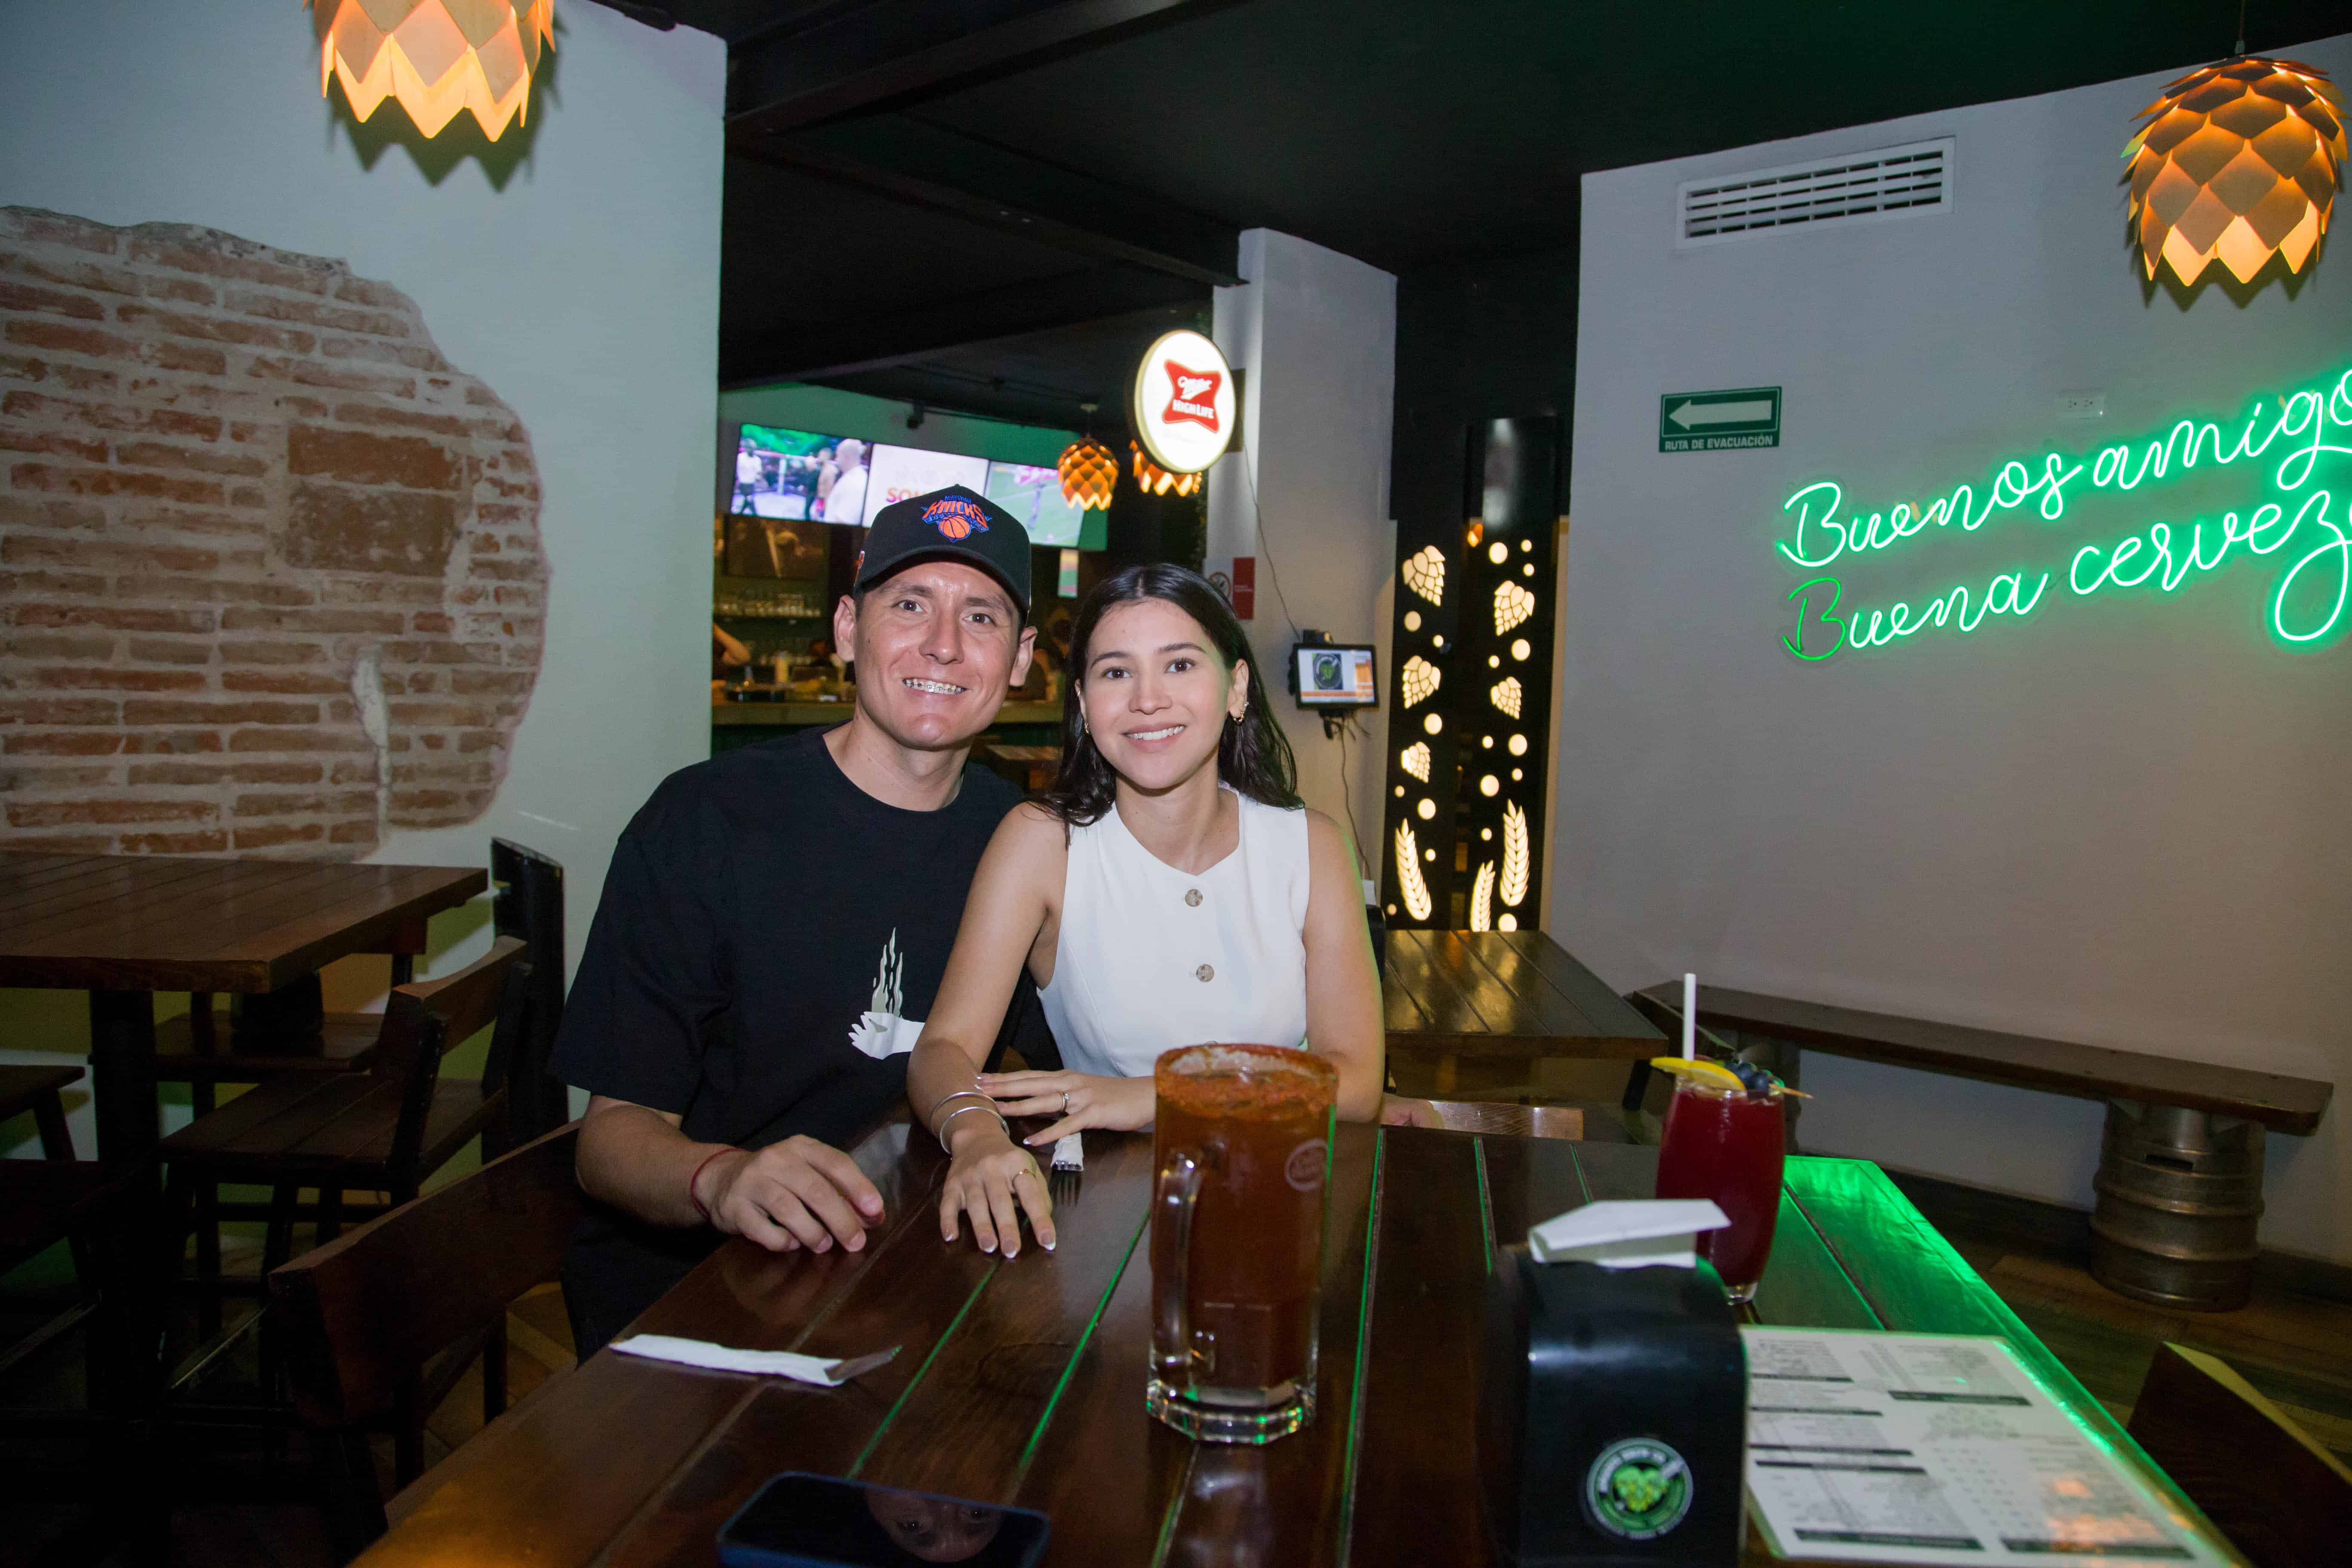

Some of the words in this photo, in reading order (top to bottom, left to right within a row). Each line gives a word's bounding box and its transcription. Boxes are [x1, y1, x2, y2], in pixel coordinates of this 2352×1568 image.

[1665, 440, 1689, 451] RUTA
[1692, 439, 1704, 449] DE
[1707, 433, 1773, 448] EVACUACIÓN
[922, 499, 988, 529] KNICKS
[1777, 453, 2083, 567] Buenos
[1782, 573, 2049, 661] Buena
[2070, 490, 2352, 641] cervez
